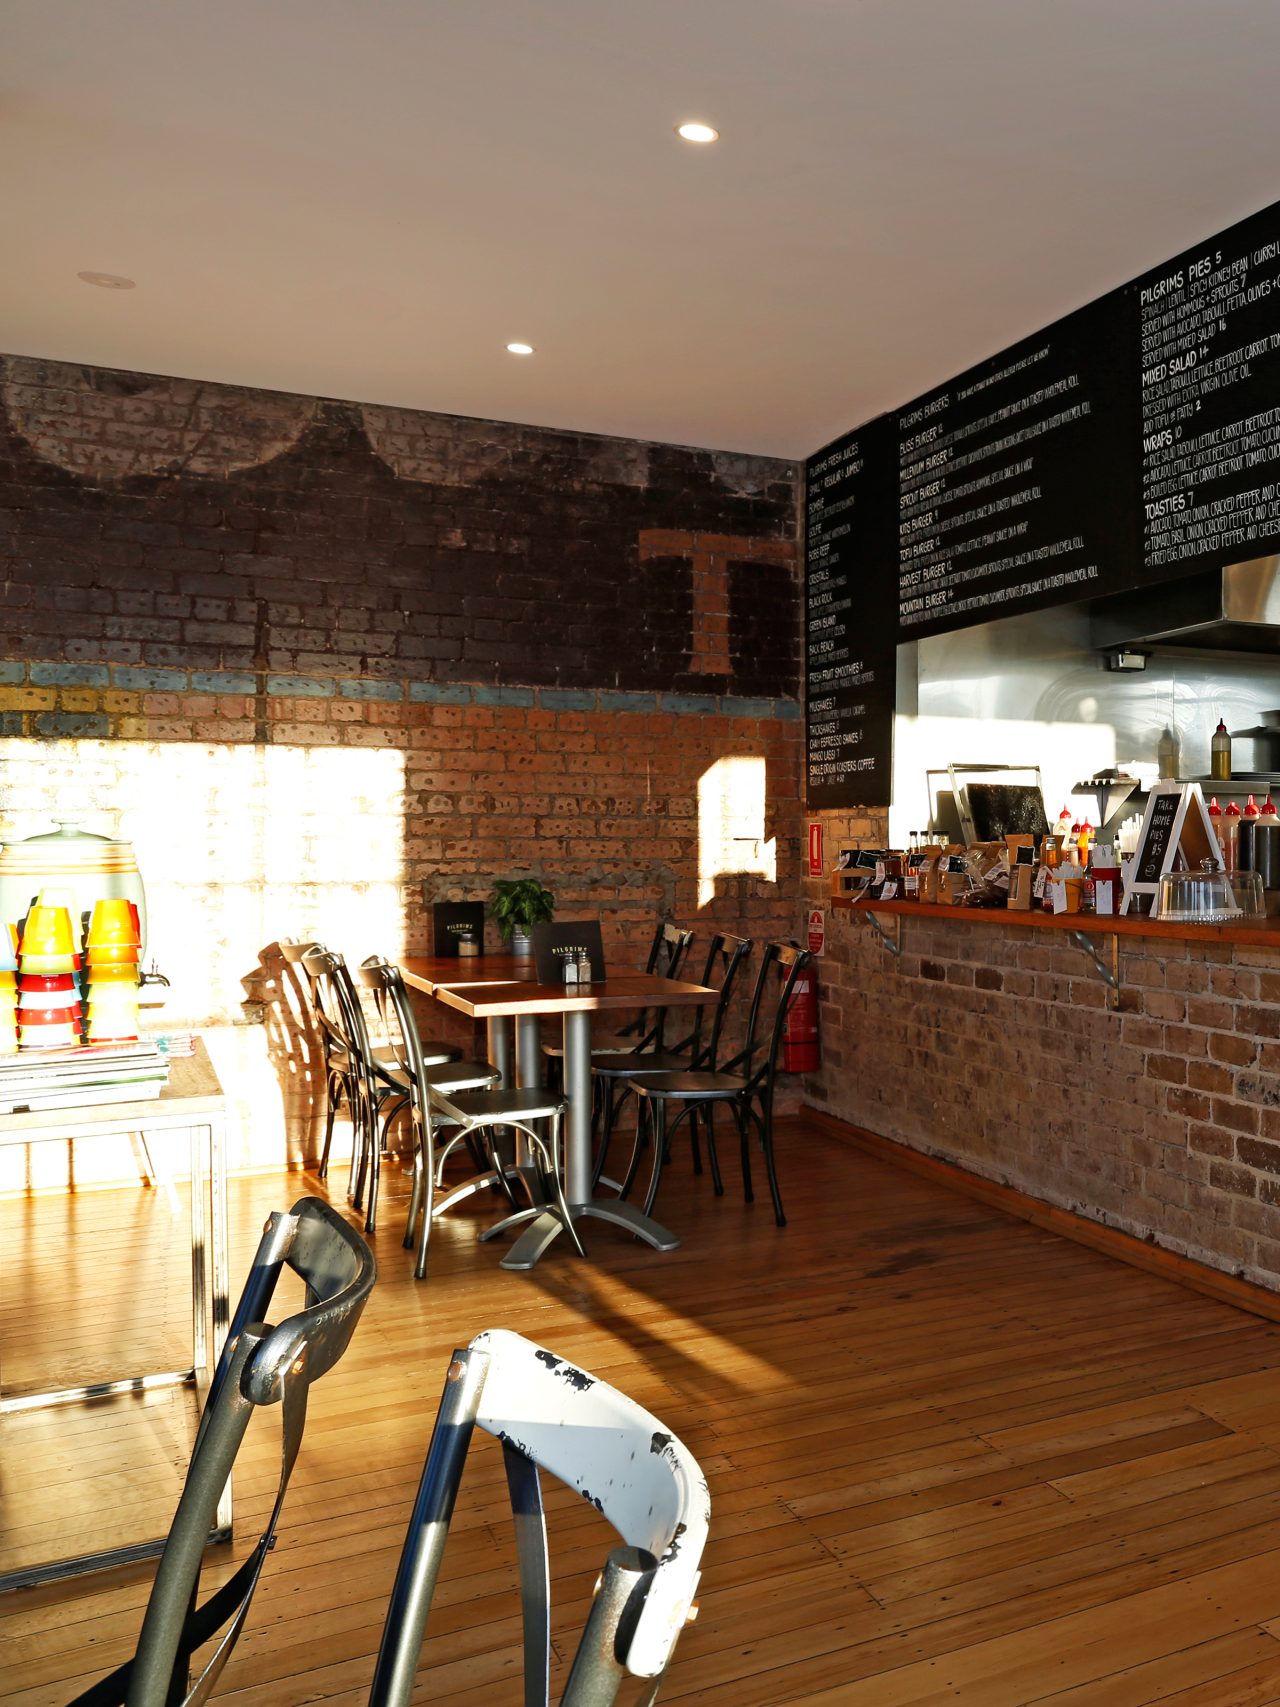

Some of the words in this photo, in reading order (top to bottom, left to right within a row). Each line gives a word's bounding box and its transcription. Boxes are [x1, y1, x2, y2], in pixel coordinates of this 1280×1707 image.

[1140, 270, 1184, 306] PILGRIMS
[1188, 256, 1212, 282] PIES
[1215, 250, 1222, 264] 5
[1168, 289, 1186, 309] LENTIL
[1190, 278, 1208, 298] SPICY
[1208, 265, 1231, 288] KIDNEY
[1231, 256, 1248, 277] BEAN
[1253, 242, 1276, 266] CURRY
[1141, 316, 1162, 337] SERVED
[1162, 310, 1175, 327] WITH
[1176, 295, 1205, 320] HOMMOUS
[1211, 278, 1239, 304] SPROUTS
[1240, 274, 1246, 288] 7
[1141, 332, 1162, 352] SERVED
[1162, 325, 1176, 343] WITH
[1247, 279, 1271, 304] OLIVES
[1142, 347, 1163, 368] SERVED
[1163, 341, 1177, 358] WITH
[1177, 332, 1196, 352] MIXED
[1197, 323, 1216, 343] SALAD
[1219, 318, 1227, 331] 16
[1142, 363, 1167, 388] MIXED
[1169, 350, 1197, 376] SALAD
[1142, 398, 1167, 418] DRESSED
[1166, 392, 1181, 408] WITH
[1182, 384, 1200, 403] EXTRA
[1200, 375, 1220, 395] VIRGIN
[1221, 367, 1239, 387] OLIVE
[1240, 363, 1252, 379] OIL
[899, 408, 923, 430] PILGRIMS
[924, 394, 949, 418] BURGERS
[1176, 403, 1193, 421] PATTY
[1195, 399, 1202, 411] 2
[900, 437, 914, 456] BLISS
[915, 426, 937, 448] BURGER
[1143, 429, 1173, 453] WRAPS
[1175, 425, 1182, 439] 10
[926, 449, 948, 471] BURGER
[919, 481, 940, 501] BURGER
[1210, 496, 1235, 517] CRACKED
[1235, 488, 1261, 509] PEPPER
[1261, 484, 1275, 502] AND
[1144, 493, 1186, 520] TOASTIES
[1187, 491, 1194, 506] 7
[911, 512, 933, 531] BURGER
[1204, 515, 1228, 537] CRACKED
[1228, 507, 1254, 529] PEPPER
[1255, 504, 1267, 521] AND
[1222, 527, 1246, 547] PEPPER
[1247, 524, 1258, 541] AND
[899, 548, 913, 561] TOFU
[913, 539, 934, 557] BURGER
[899, 570, 922, 588] HARVEST
[923, 562, 946, 582] BURGER
[899, 597, 924, 615] MOUNTAIN
[925, 590, 947, 609] BURGER
[857, 757, 876, 771] COFFEE
[1158, 799, 1174, 811] TAKE
[1152, 815, 1171, 826] HOME
[447, 923, 473, 931] PILGRIMS
